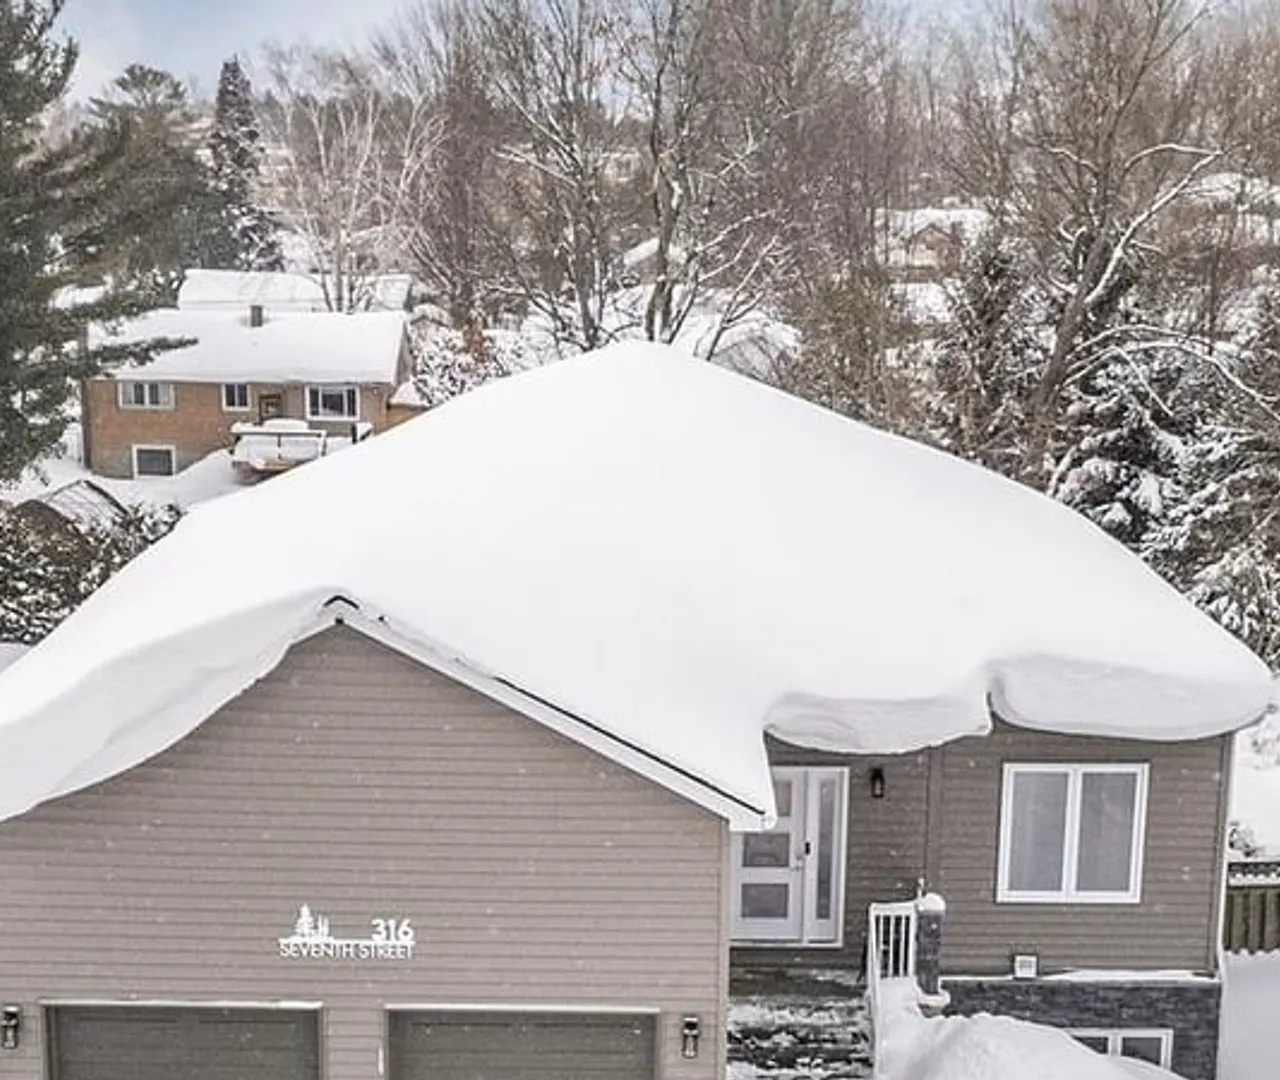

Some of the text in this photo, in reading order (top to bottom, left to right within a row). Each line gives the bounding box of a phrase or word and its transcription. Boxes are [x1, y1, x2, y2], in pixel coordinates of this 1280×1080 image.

[371, 918, 413, 941] 316
[279, 939, 414, 959] SEVENTH STREET
